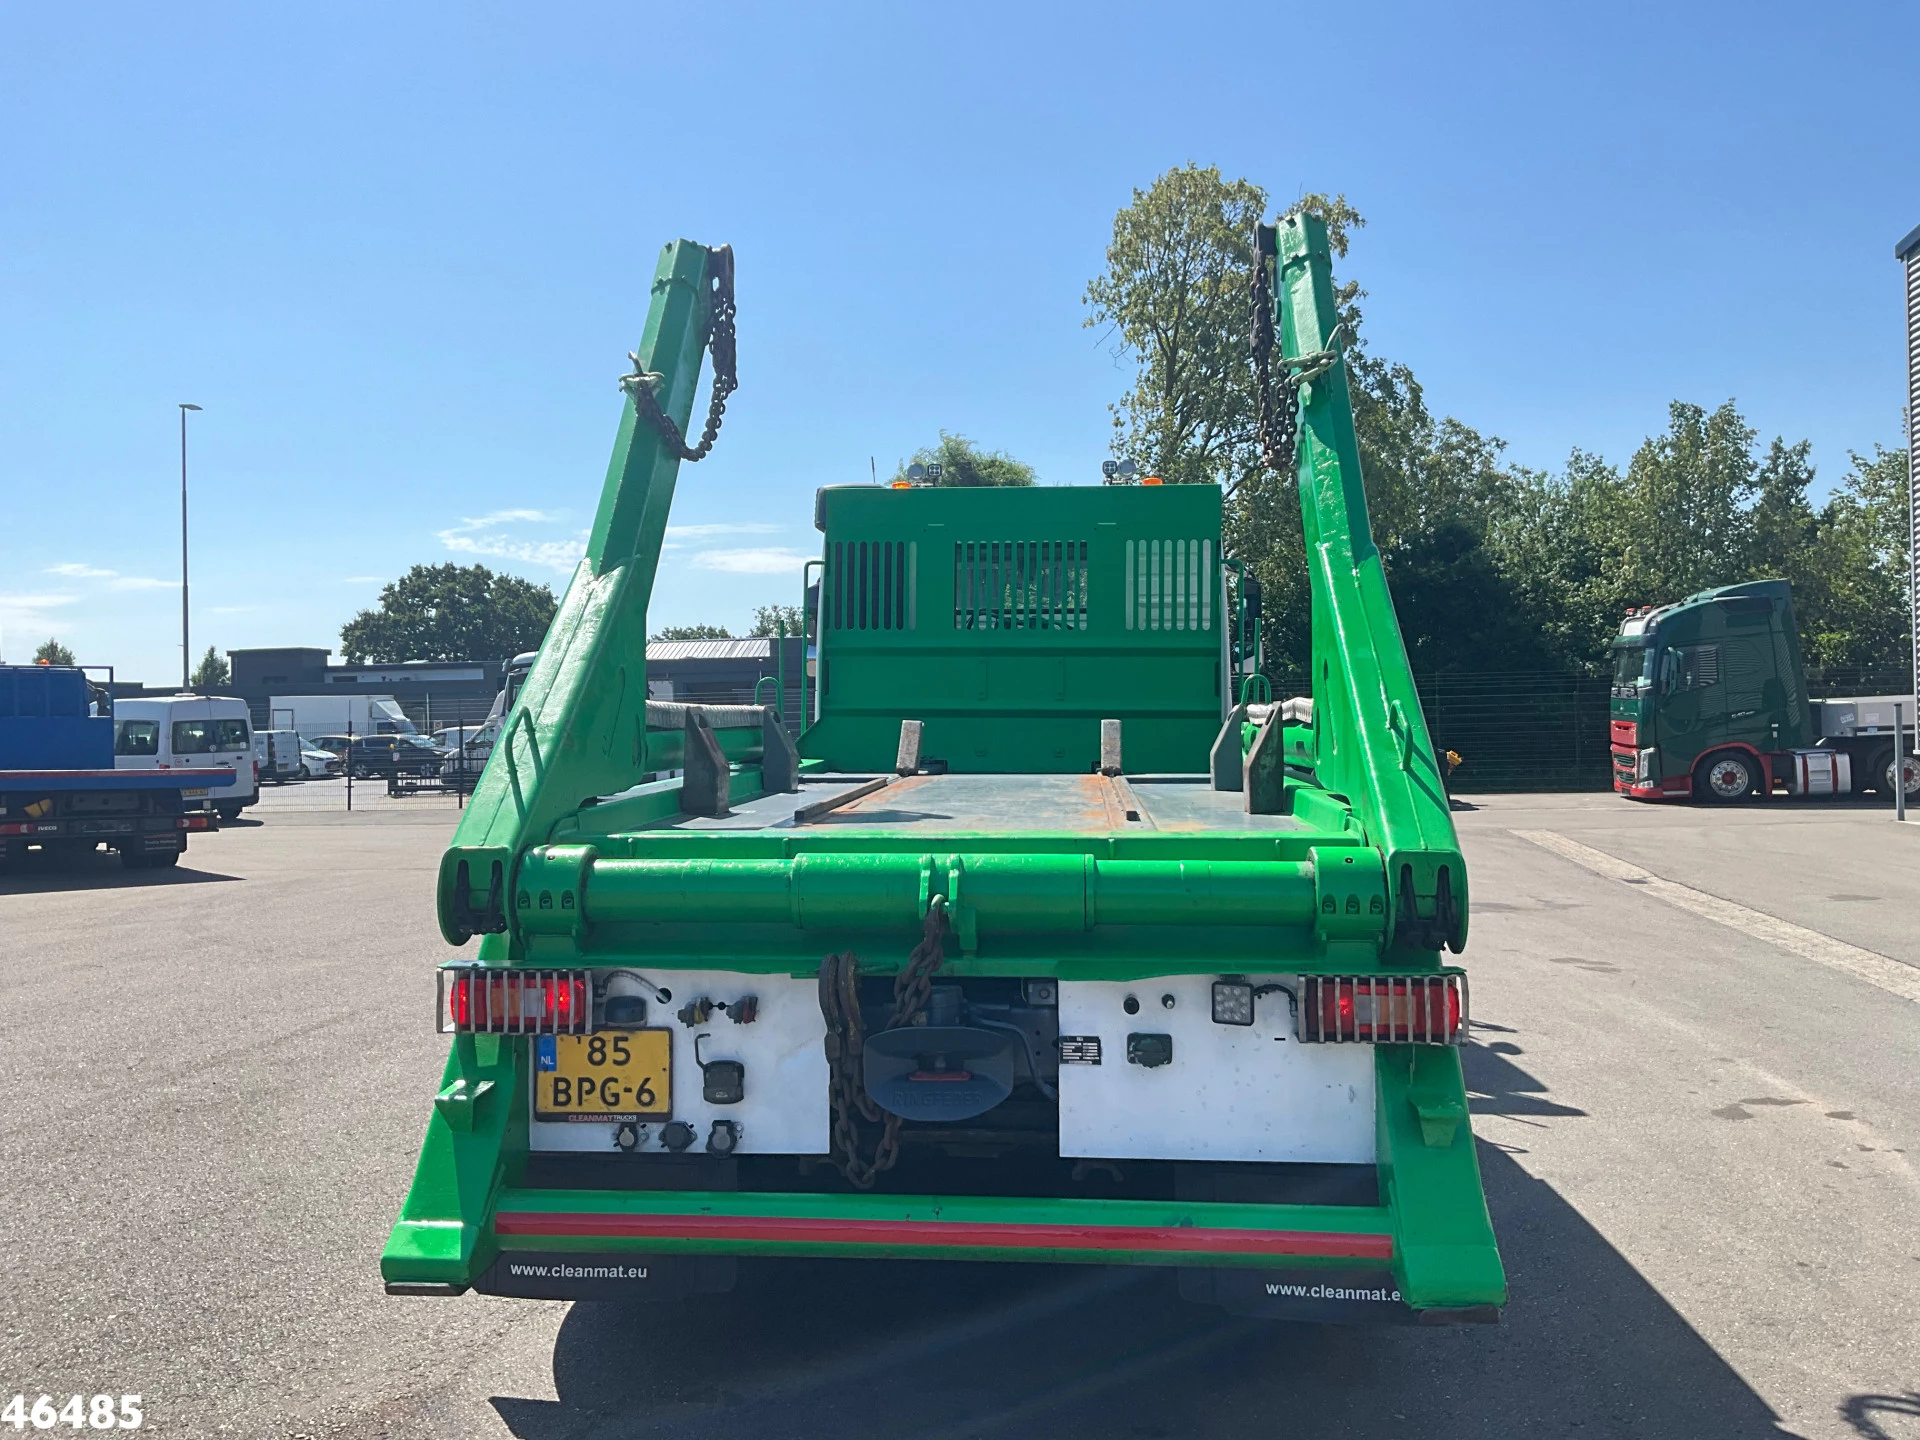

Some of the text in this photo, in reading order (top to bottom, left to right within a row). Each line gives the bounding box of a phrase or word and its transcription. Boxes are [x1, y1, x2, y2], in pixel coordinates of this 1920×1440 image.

[540, 1055, 554, 1066] NL
[587, 1036, 631, 1067] 85
[552, 1077, 656, 1108] BPG-6
[510, 1264, 647, 1278] www.cleanmat.eu
[1266, 1283, 1405, 1302] www.cleanmat.e
